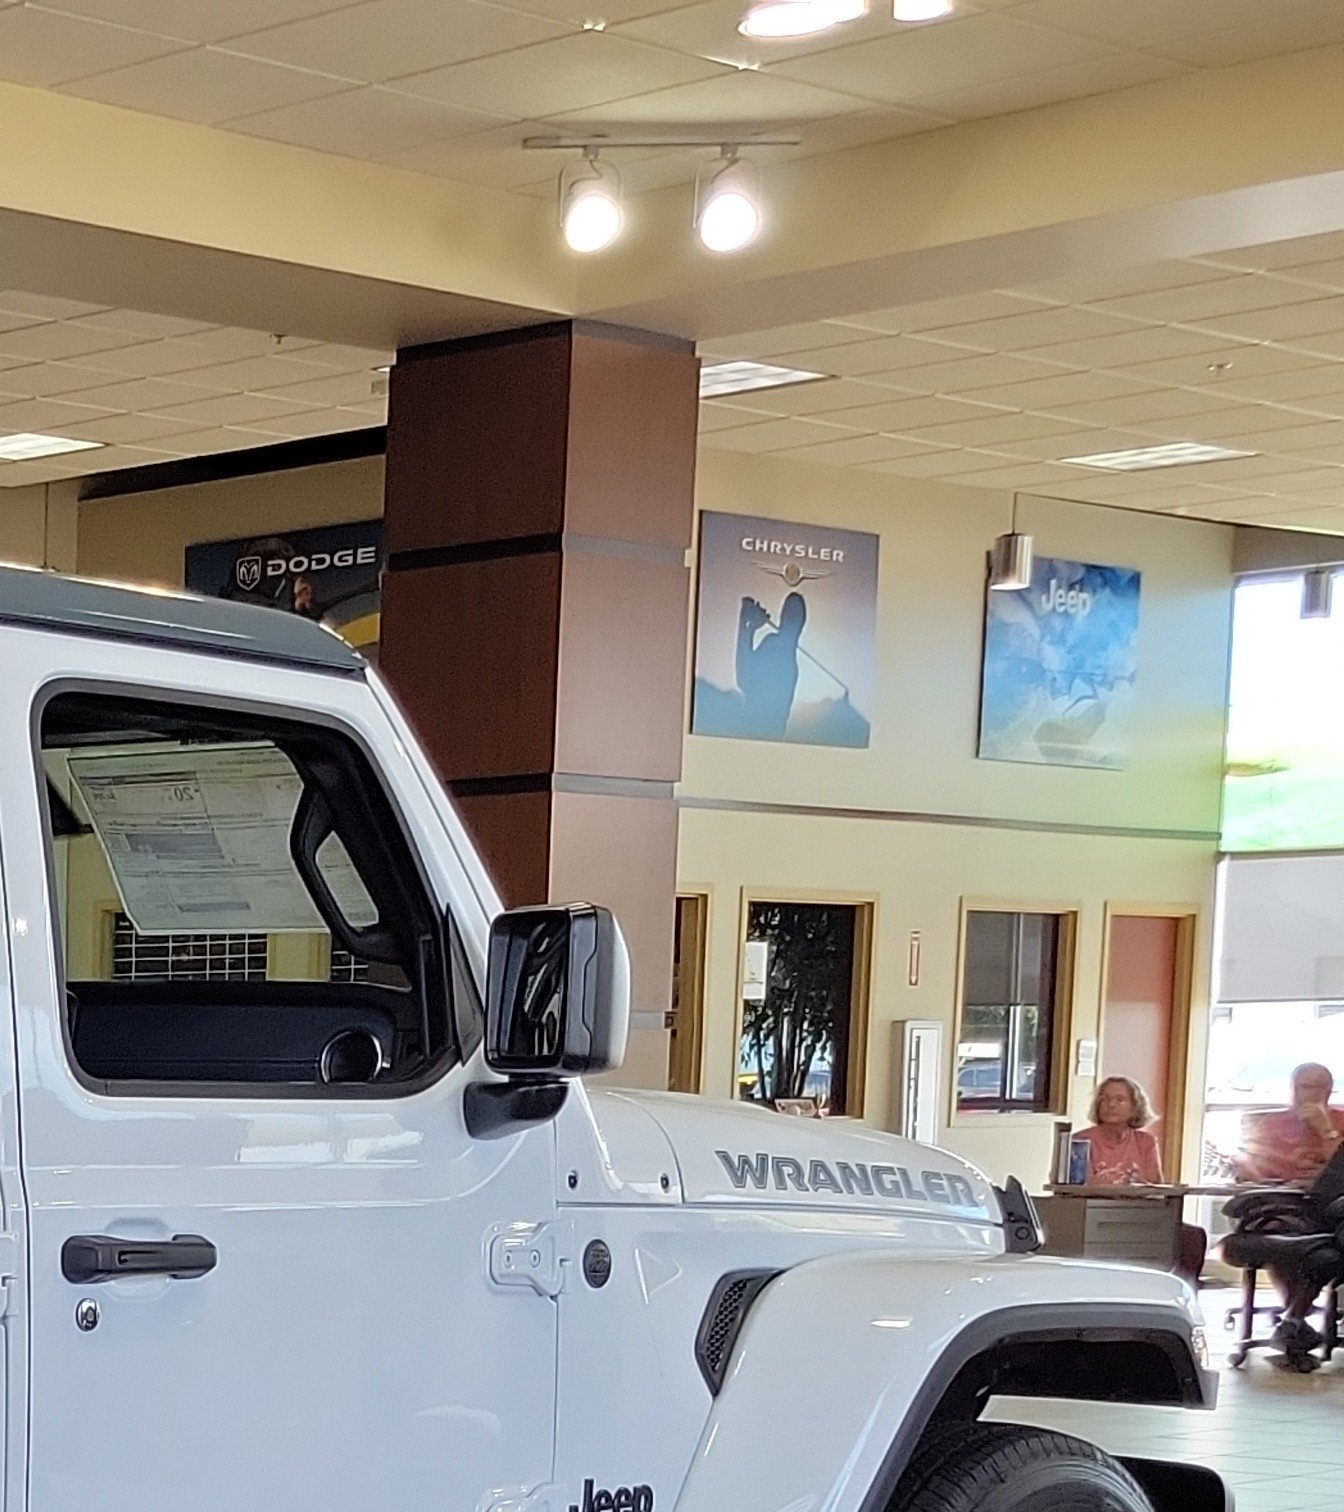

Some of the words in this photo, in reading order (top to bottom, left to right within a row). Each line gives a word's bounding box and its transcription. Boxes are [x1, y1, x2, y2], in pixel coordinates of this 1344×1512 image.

[266, 546, 376, 577] DODGE
[741, 537, 844, 563] CHRYSLER
[1041, 578, 1092, 623] Jeep
[714, 1150, 980, 1208] WRANGLER
